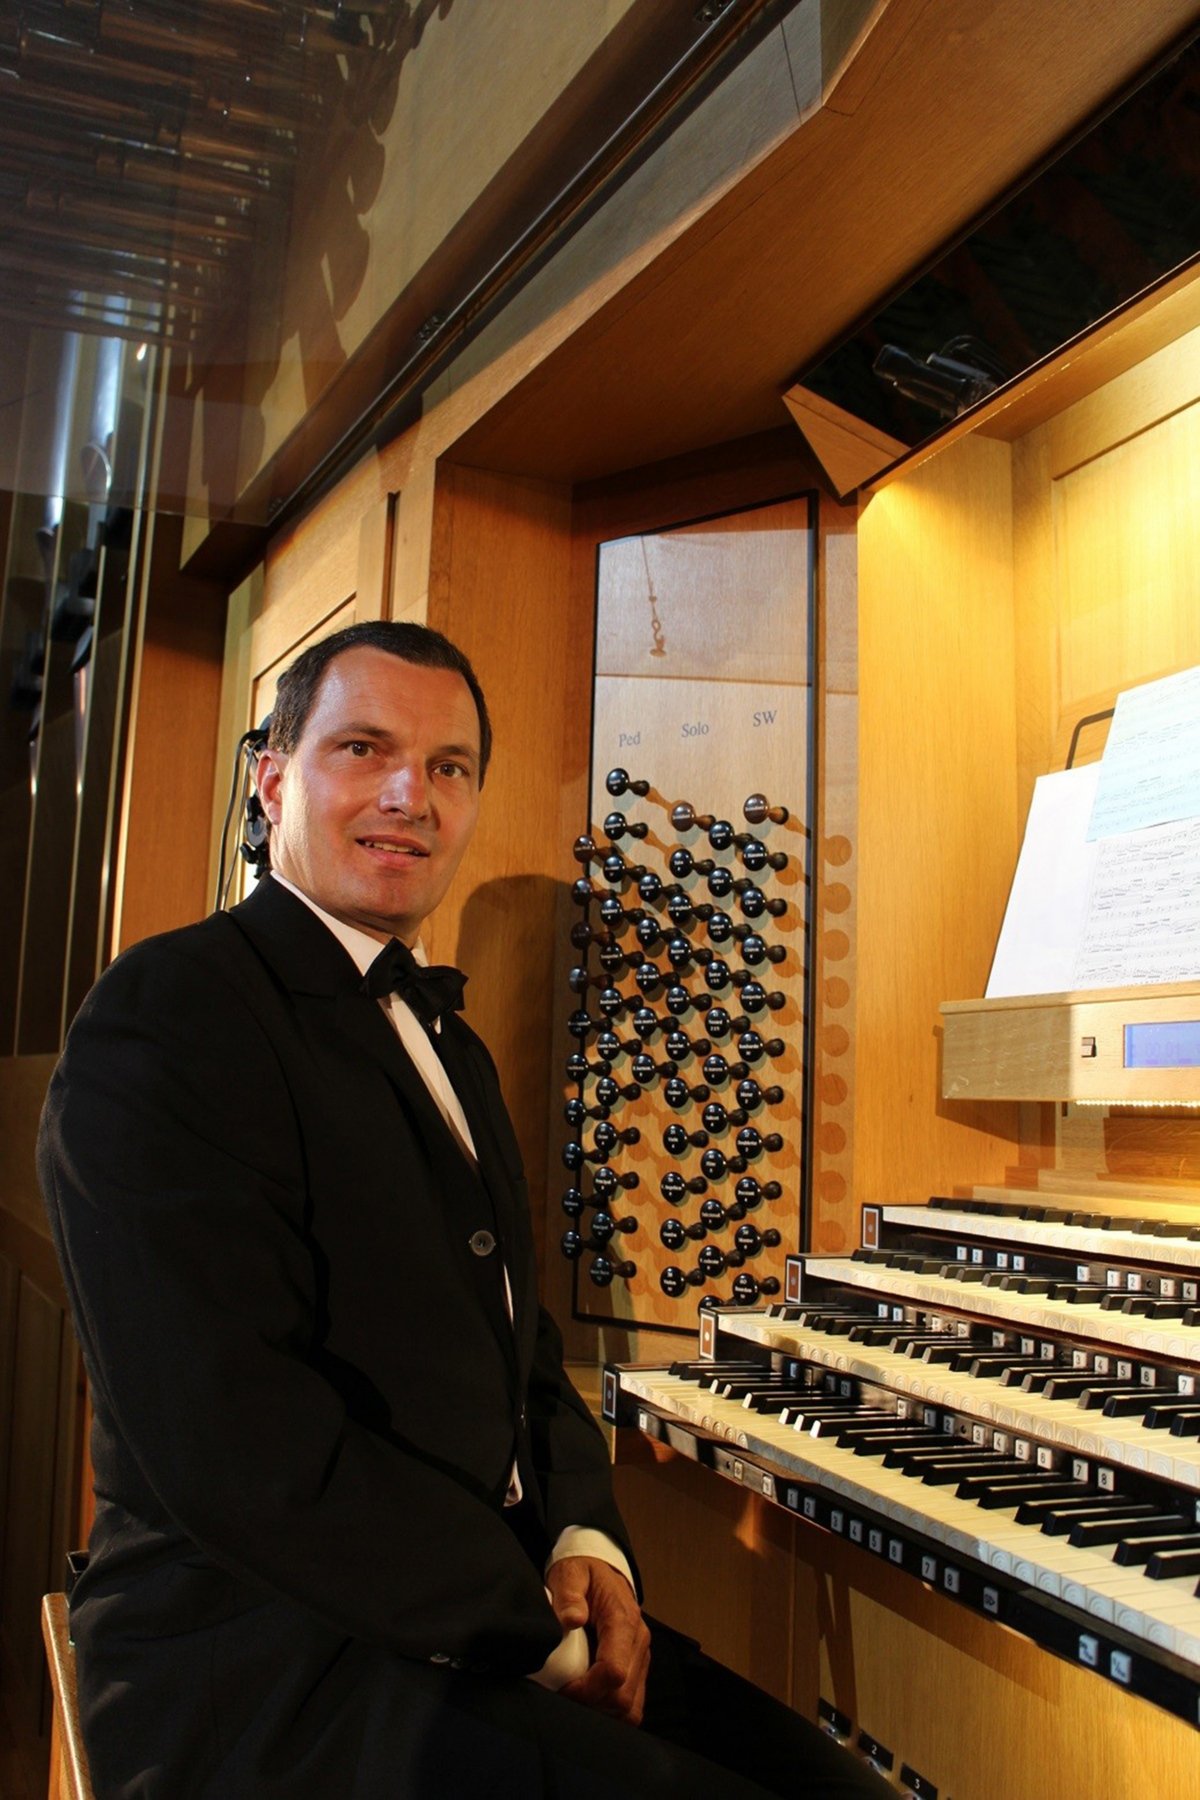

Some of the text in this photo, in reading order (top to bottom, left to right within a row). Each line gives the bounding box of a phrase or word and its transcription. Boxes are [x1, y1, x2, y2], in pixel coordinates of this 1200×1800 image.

[618, 710, 778, 748] Ped Solo SW
[975, 1252, 979, 1261] 2
[1016, 1258, 1021, 1267] 4
[1110, 1274, 1114, 1283] 1
[1131, 1277, 1136, 1287] 2
[1163, 1282, 1168, 1292] 3
[1186, 1286, 1191, 1296] 4
[1024, 1342, 1028, 1352] 1
[1044, 1347, 1049, 1357] 2
[1076, 1355, 1081, 1365] 3
[1097, 1360, 1102, 1370] 4
[1121, 1365, 1126, 1376] 5
[1144, 1371, 1149, 1382] 6
[1182, 1380, 1187, 1391] 7
[927, 1412, 931, 1423] 1
[946, 1419, 951, 1430] 2
[976, 1430, 981, 1440] 3
[1018, 1444, 1023, 1455] 5
[1040, 1453, 1046, 1464] 6
[1076, 1464, 1082, 1476] 7
[1101, 1473, 1107, 1485] 8
[790, 1493, 794, 1503] 1
[806, 1502, 810, 1513] 2
[833, 1516, 838, 1527] 3
[852, 1525, 857, 1537] 4
[872, 1535, 877, 1547] 5
[925, 1562, 930, 1574] 7
[947, 1574, 953, 1586] 8
[831, 1713, 836, 1722] 1
[871, 1744, 878, 1755] 2
[914, 1778, 921, 1789] 3
